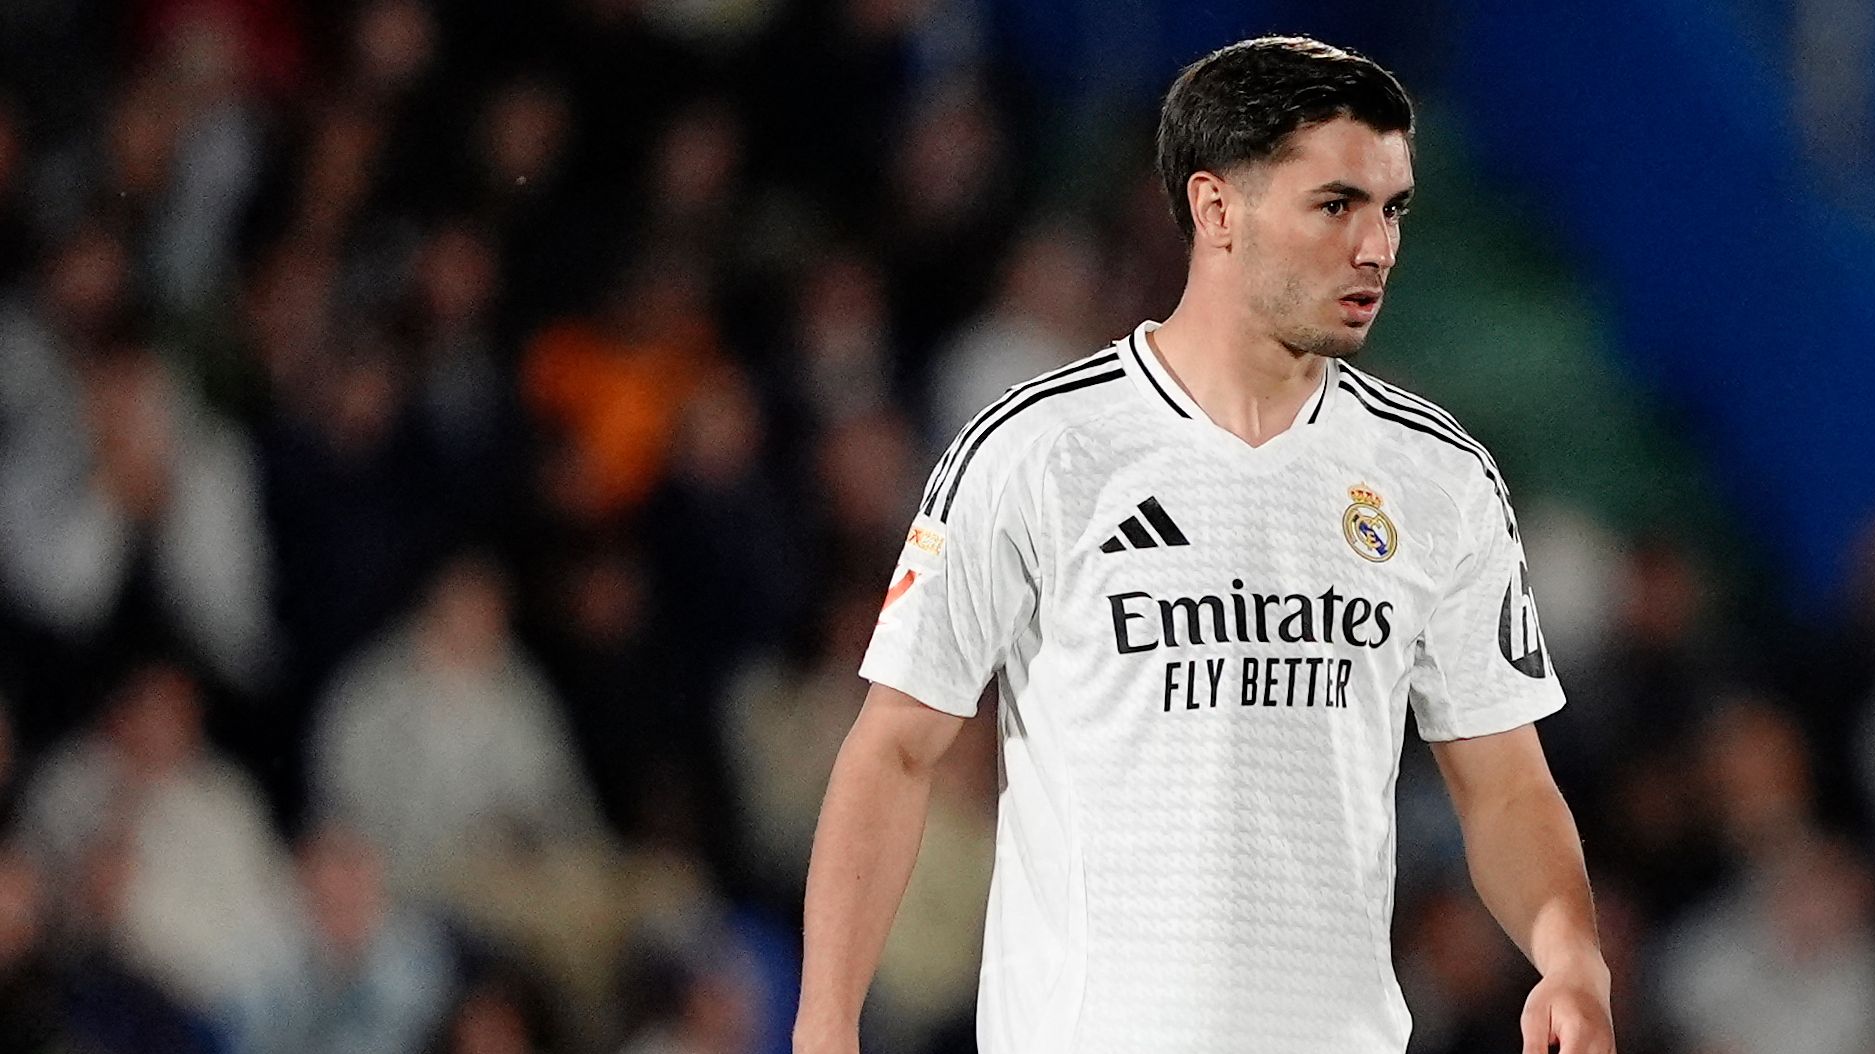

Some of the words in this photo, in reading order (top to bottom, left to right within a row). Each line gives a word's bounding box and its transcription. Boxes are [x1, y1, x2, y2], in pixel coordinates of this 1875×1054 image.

[1107, 578, 1394, 655] Emirates
[1164, 658, 1225, 712] FLY
[1241, 657, 1352, 708] BETTER
